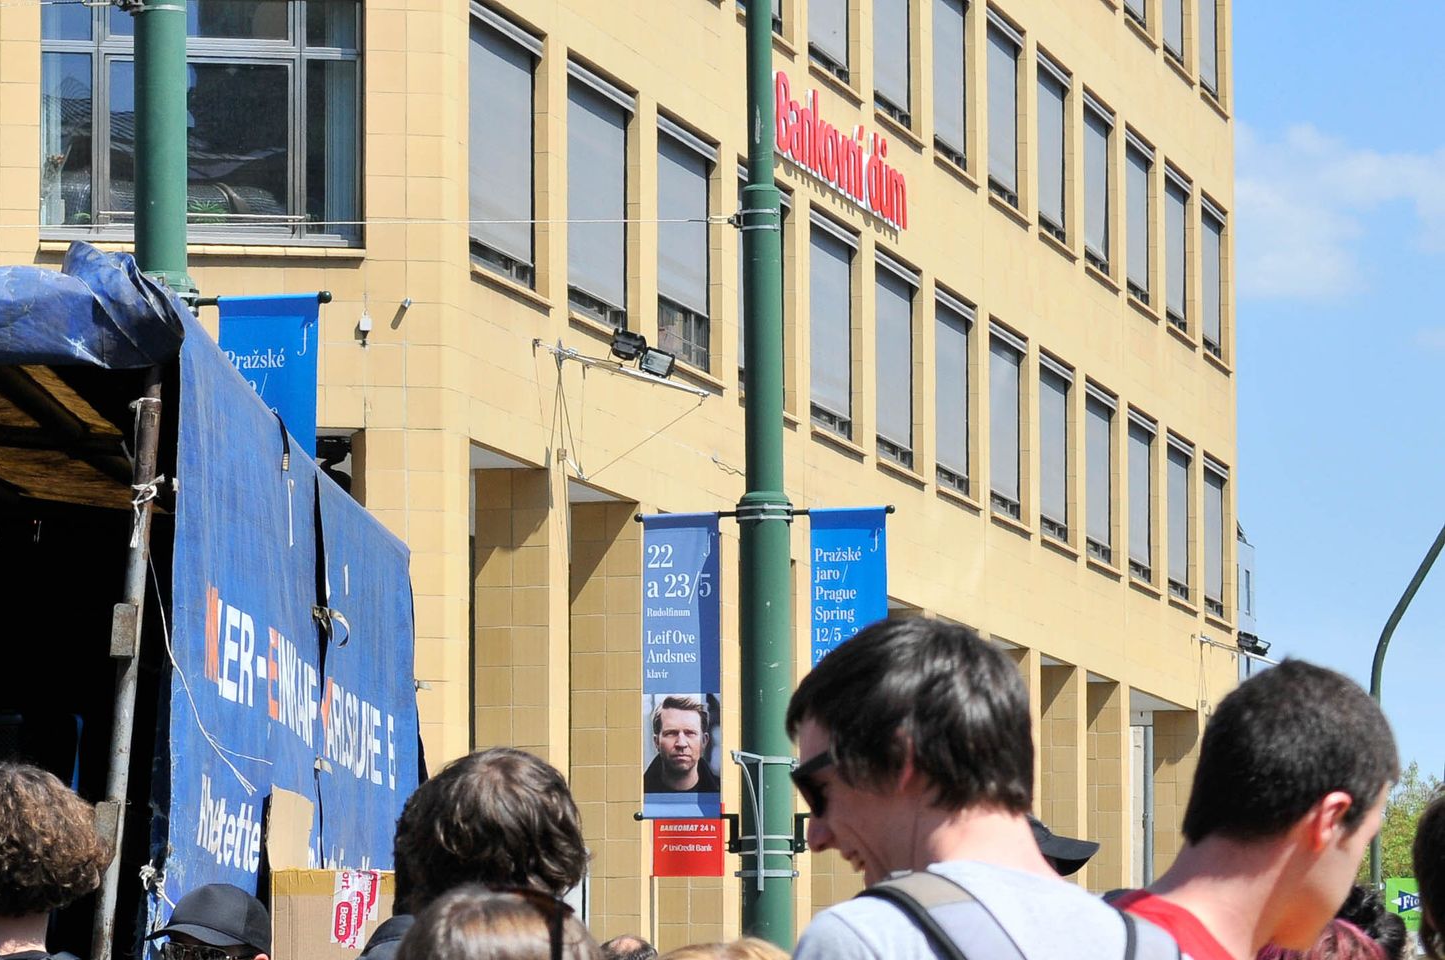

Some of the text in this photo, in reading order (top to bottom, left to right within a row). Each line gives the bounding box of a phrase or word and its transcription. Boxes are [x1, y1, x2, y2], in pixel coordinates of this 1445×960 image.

[776, 71, 907, 230] Bankovní dům
[647, 544, 673, 568] 22
[815, 546, 862, 562] Pražské
[815, 567, 840, 583] jaro
[647, 571, 712, 604] a 23/5
[815, 586, 857, 603] Prague
[647, 607, 691, 617] Rudolfinum
[815, 606, 855, 624] Spring
[647, 630, 695, 644] Leif Ove
[647, 649, 696, 663] Andsnes
[668, 844, 714, 852] UniCredit Bank
